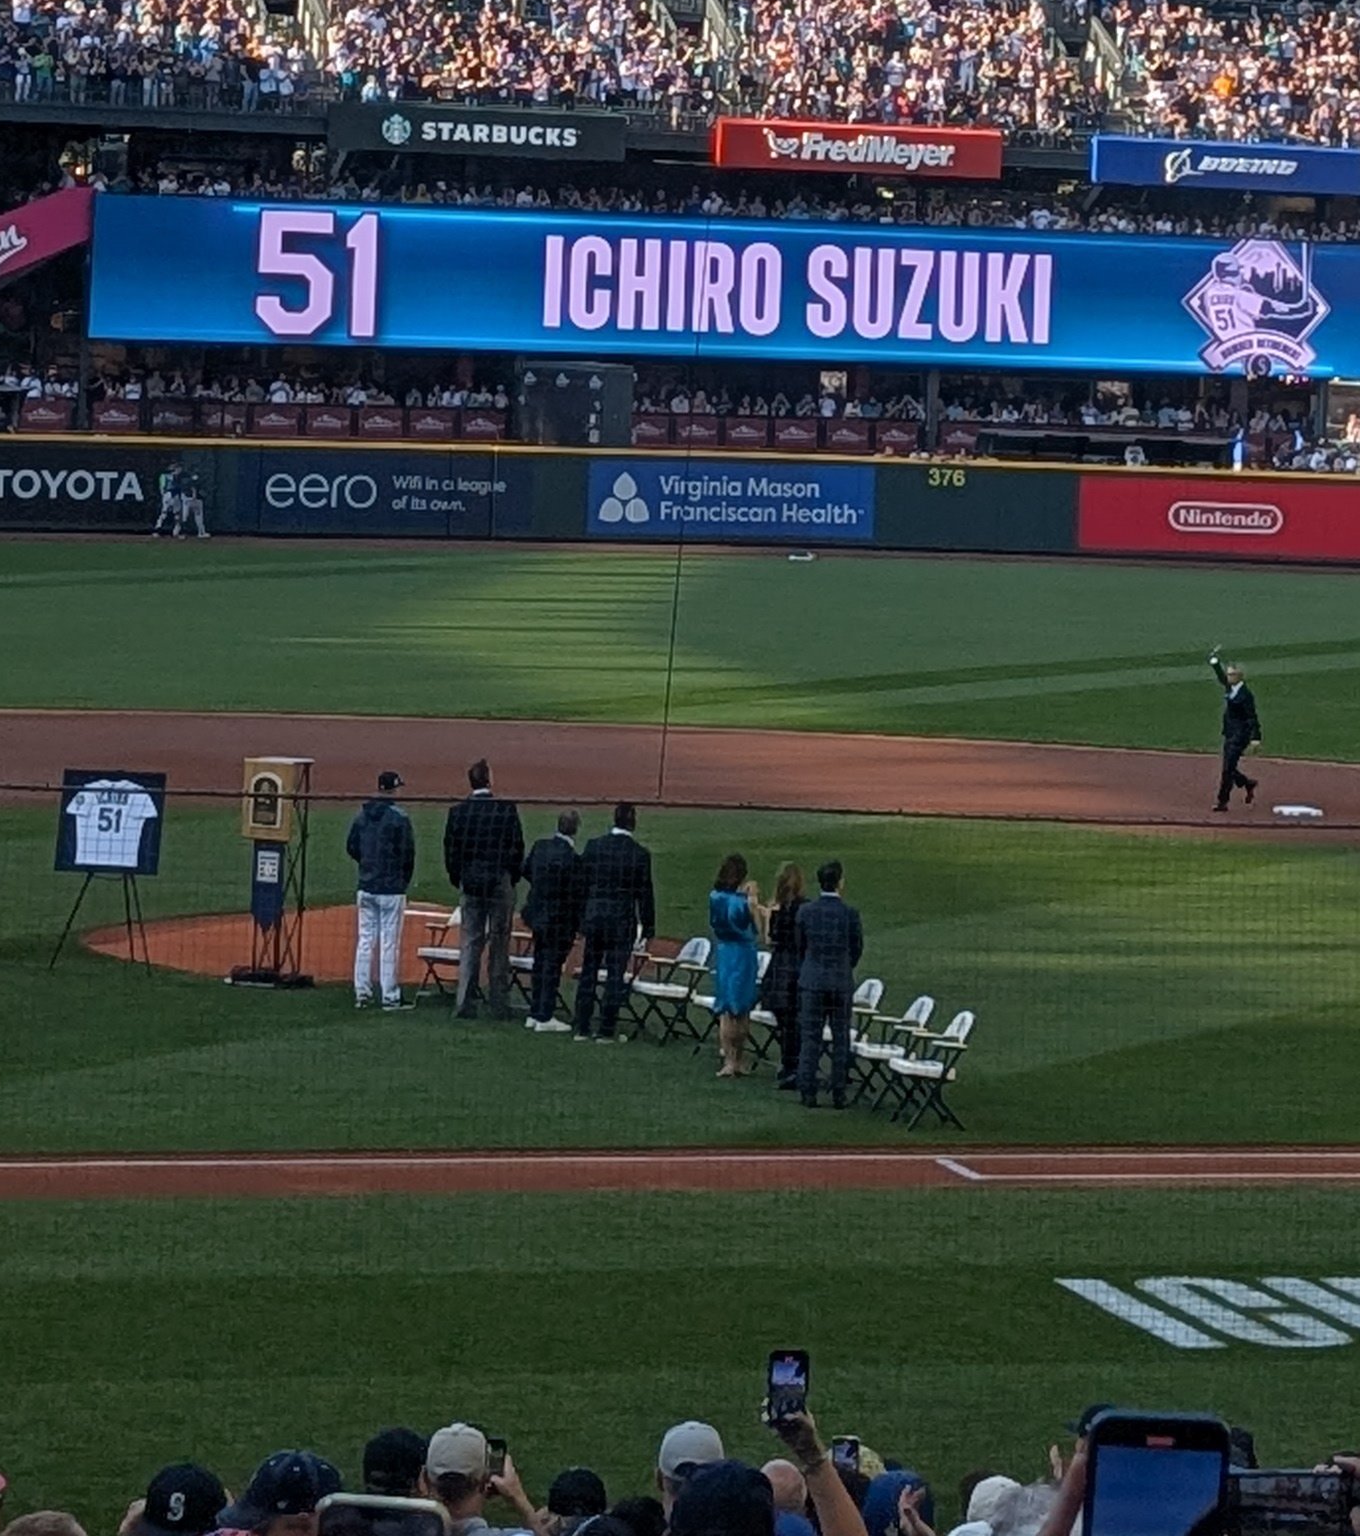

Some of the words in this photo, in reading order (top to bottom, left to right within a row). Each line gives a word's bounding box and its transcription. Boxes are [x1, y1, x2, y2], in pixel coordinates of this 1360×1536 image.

[421, 122, 577, 147] STARBUCKS
[1197, 156, 1298, 175] BOEING
[256, 210, 378, 337] 51
[543, 235, 782, 336] ICHIRO
[806, 245, 1052, 344] SUZUKI
[1215, 308, 1236, 332] 51
[426, 476, 439, 490] in
[442, 479, 454, 490] a
[457, 477, 507, 496] league
[659, 475, 742, 500] Virginia
[747, 478, 820, 498] Mason
[928, 469, 965, 486] 376
[265, 474, 377, 508] eero
[392, 495, 407, 510] of
[411, 495, 427, 510] its
[660, 501, 776, 522] Franciscan
[782, 504, 857, 524] Health
[1179, 508, 1274, 528] Nintendo
[98, 807, 122, 833] 51
[167, 1492, 186, 1521] S
